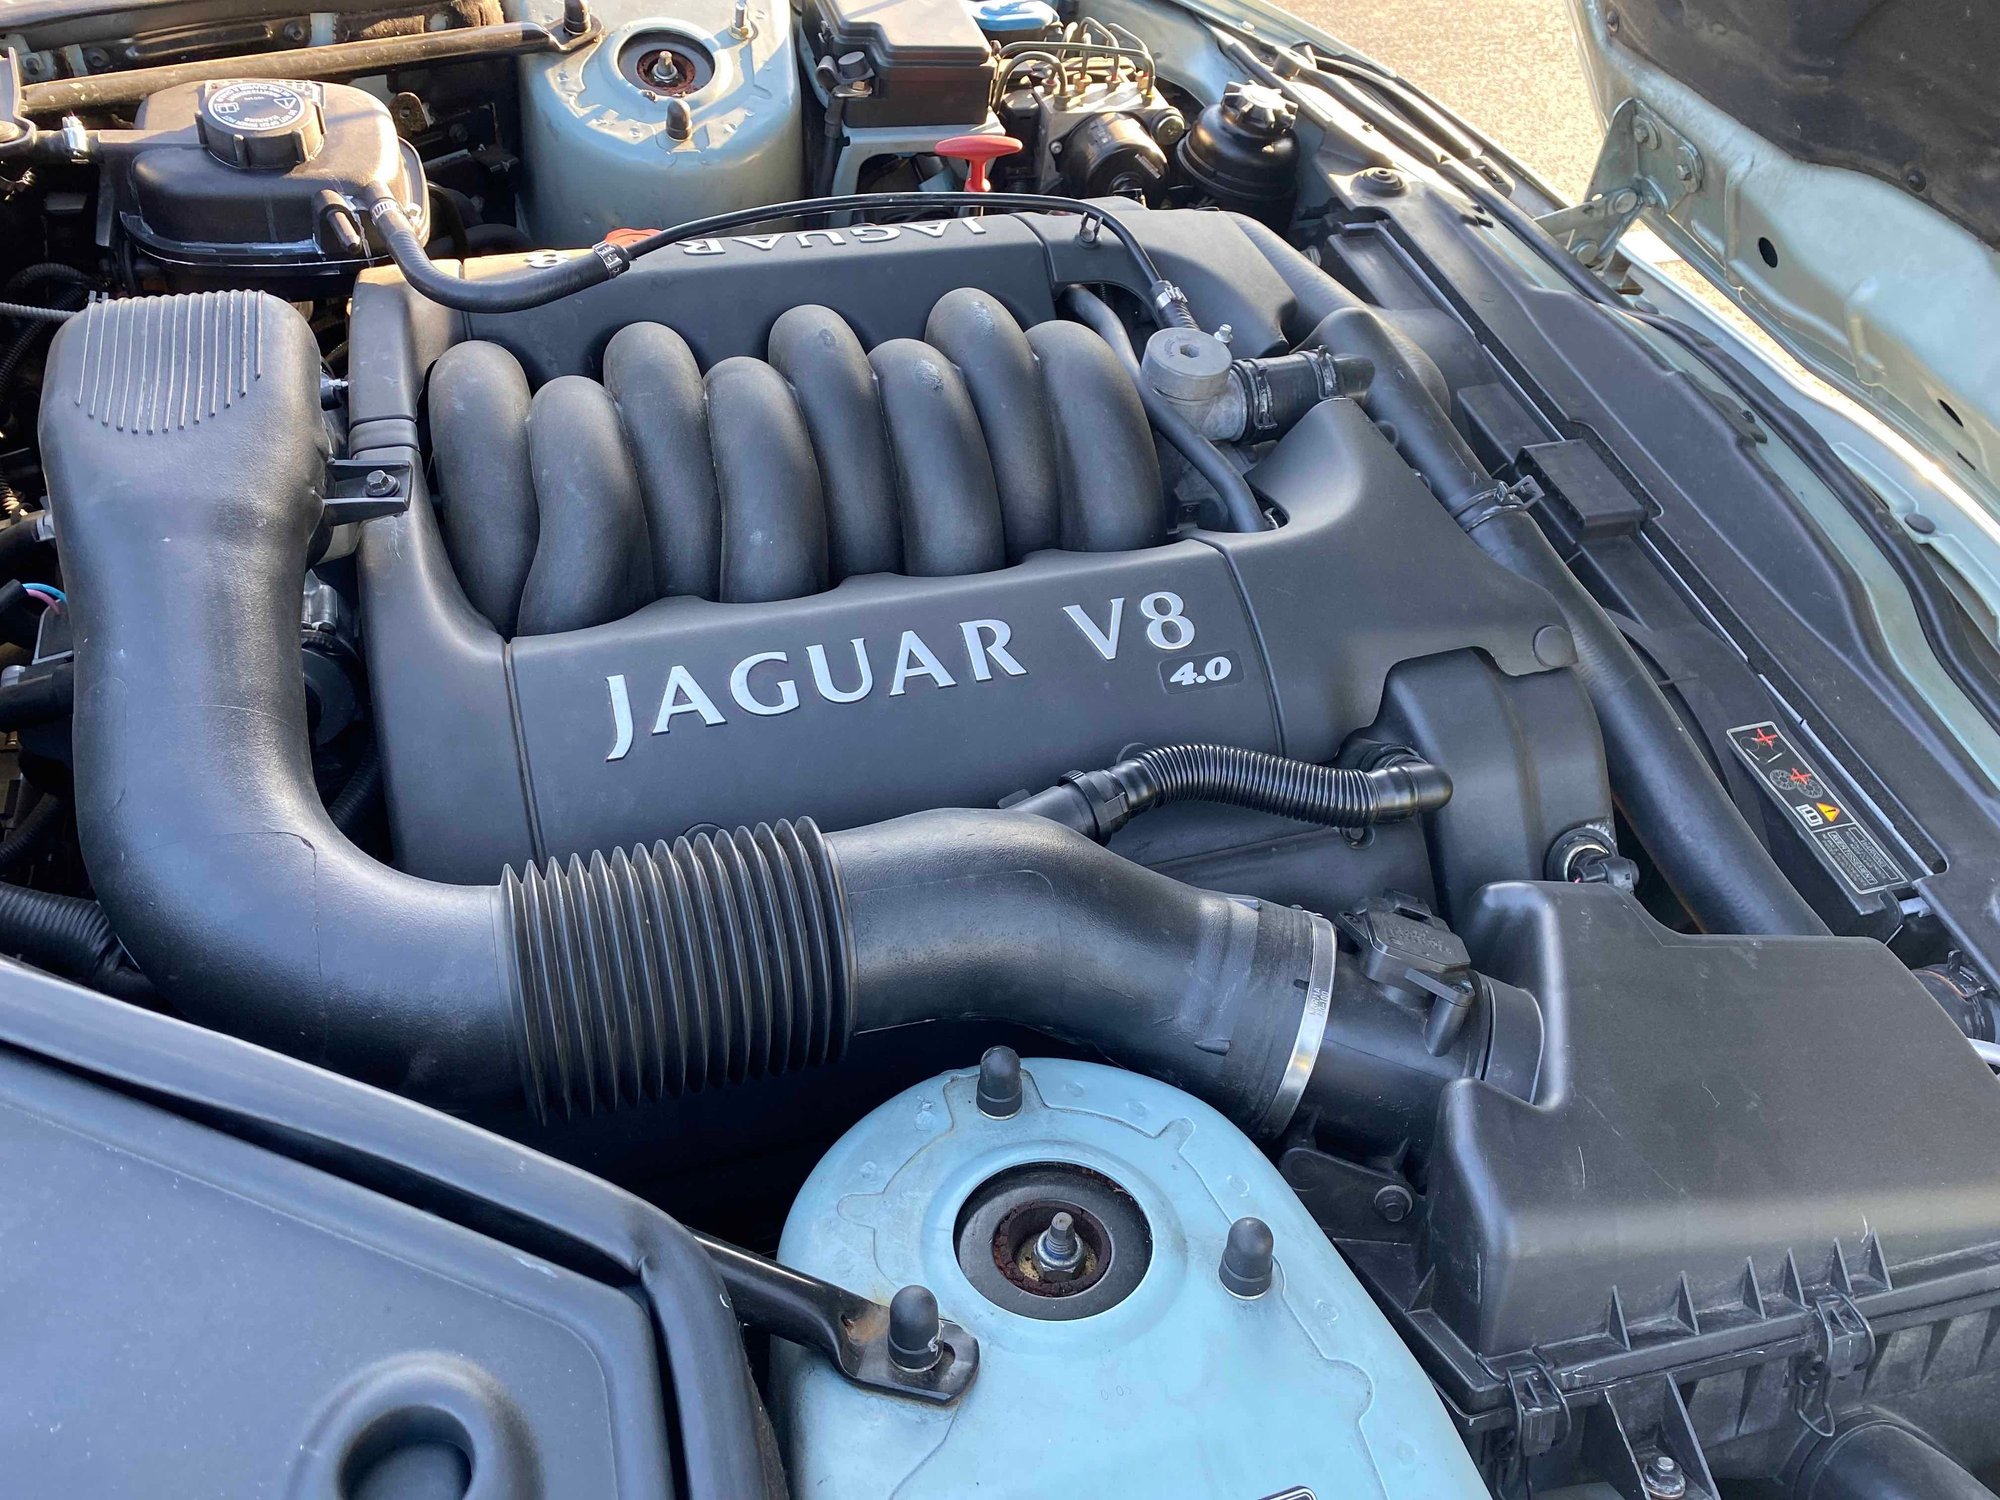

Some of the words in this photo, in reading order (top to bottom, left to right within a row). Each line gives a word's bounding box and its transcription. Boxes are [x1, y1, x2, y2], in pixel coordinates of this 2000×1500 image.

[675, 217, 987, 256] JAGUAR
[605, 619, 1029, 762] JAGUAR
[1062, 591, 1196, 660] V8
[1169, 656, 1232, 686] 4.0
